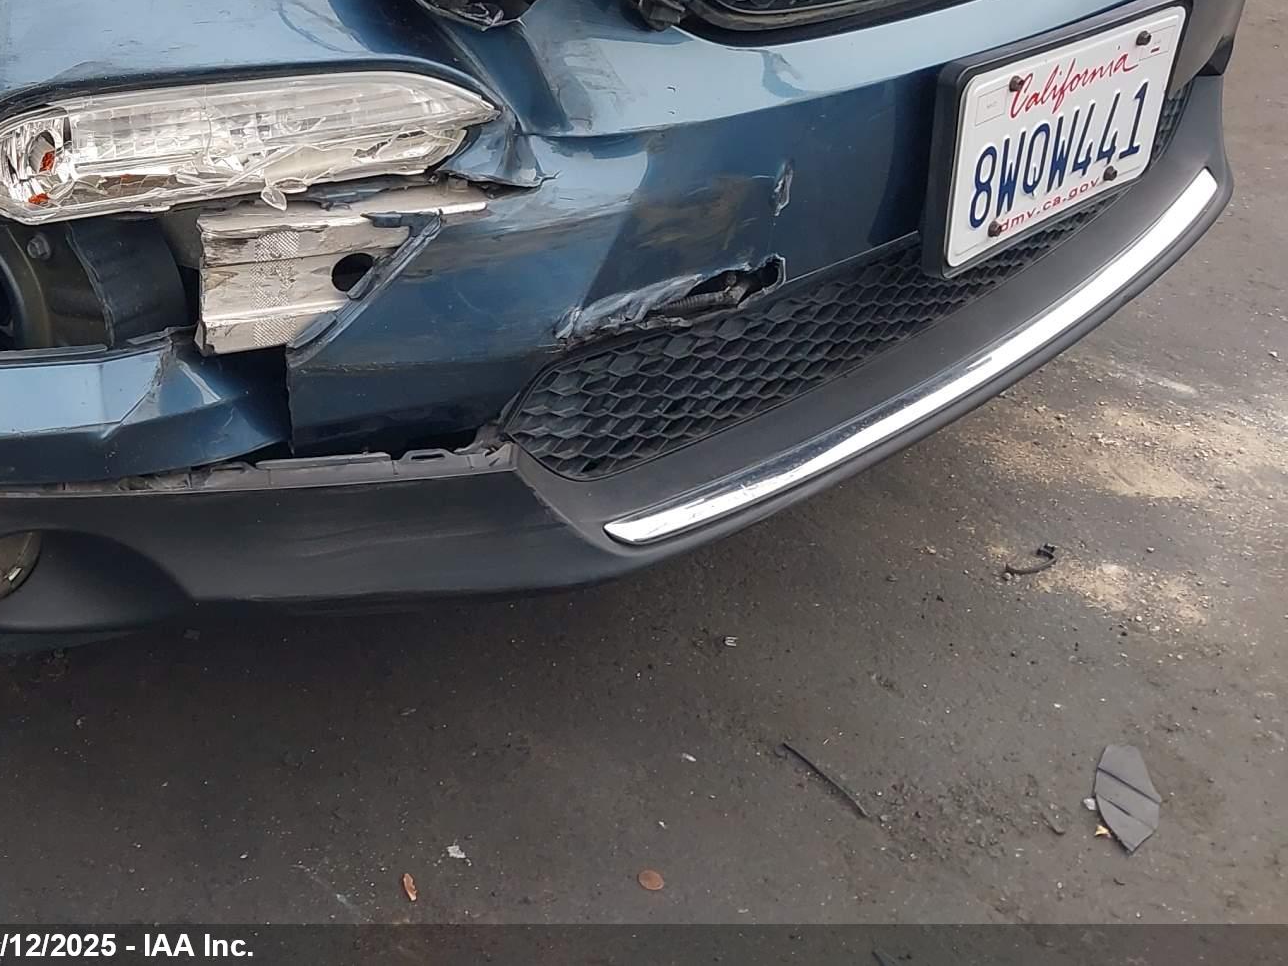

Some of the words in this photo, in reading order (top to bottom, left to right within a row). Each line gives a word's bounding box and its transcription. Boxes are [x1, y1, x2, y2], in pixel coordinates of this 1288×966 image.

[1008, 47, 1139, 119] California
[969, 81, 1149, 229] 8WQW441
[999, 176, 1100, 234] dmv.ca.gov
